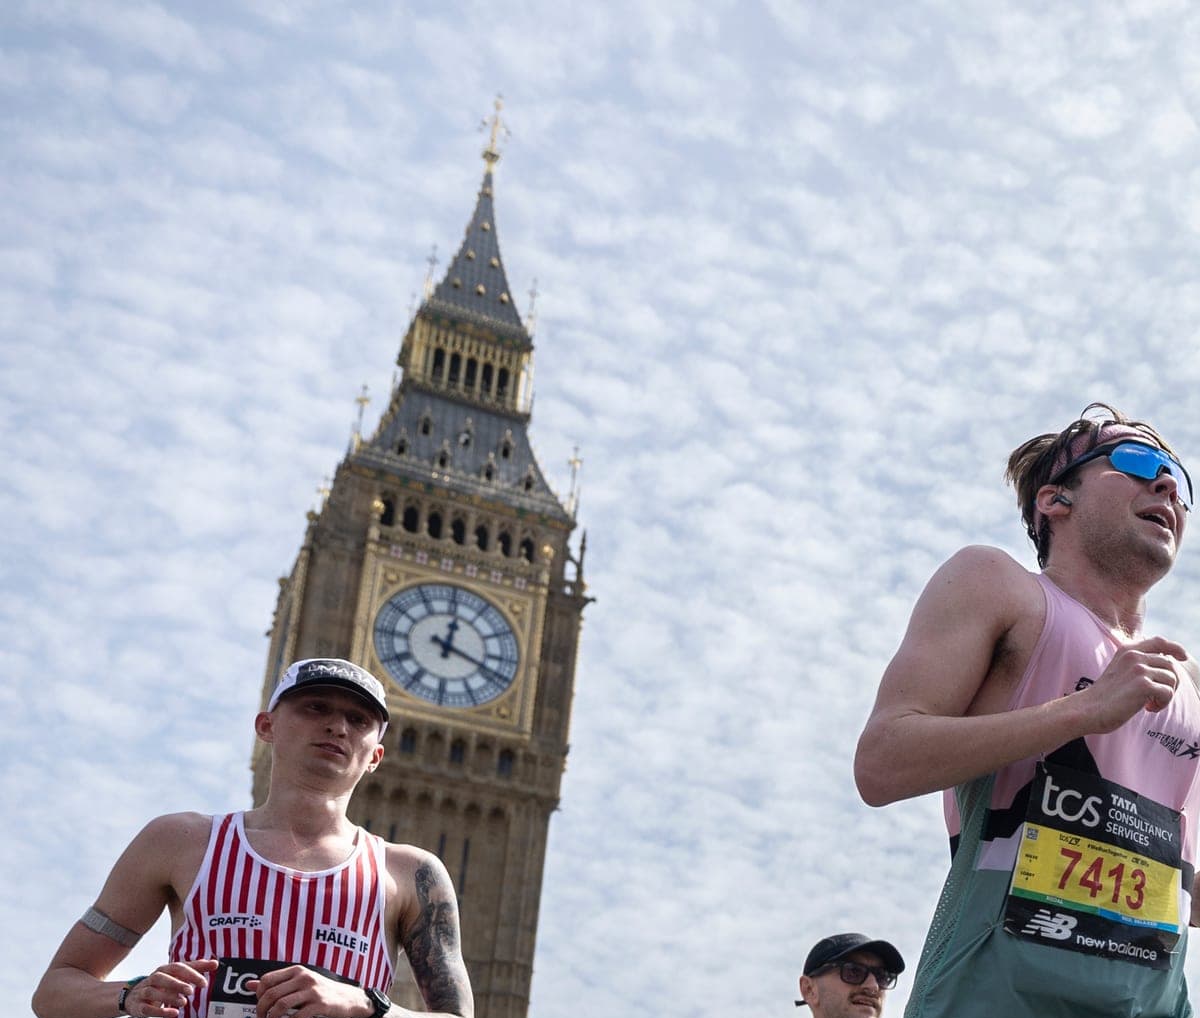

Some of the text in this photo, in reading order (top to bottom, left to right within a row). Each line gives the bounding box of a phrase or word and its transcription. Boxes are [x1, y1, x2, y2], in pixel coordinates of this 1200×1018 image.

[1041, 775, 1102, 827] tcs
[1111, 793, 1137, 814] TATA
[1105, 822, 1150, 846] SERVICES
[1108, 808, 1174, 842] CONSULTANCY
[1058, 847, 1146, 910] 7413
[209, 916, 249, 927] CRAFT
[316, 928, 357, 950] HÄLLE
[1076, 935, 1106, 949] new
[1108, 940, 1158, 961] balance
[223, 966, 259, 996] tc
